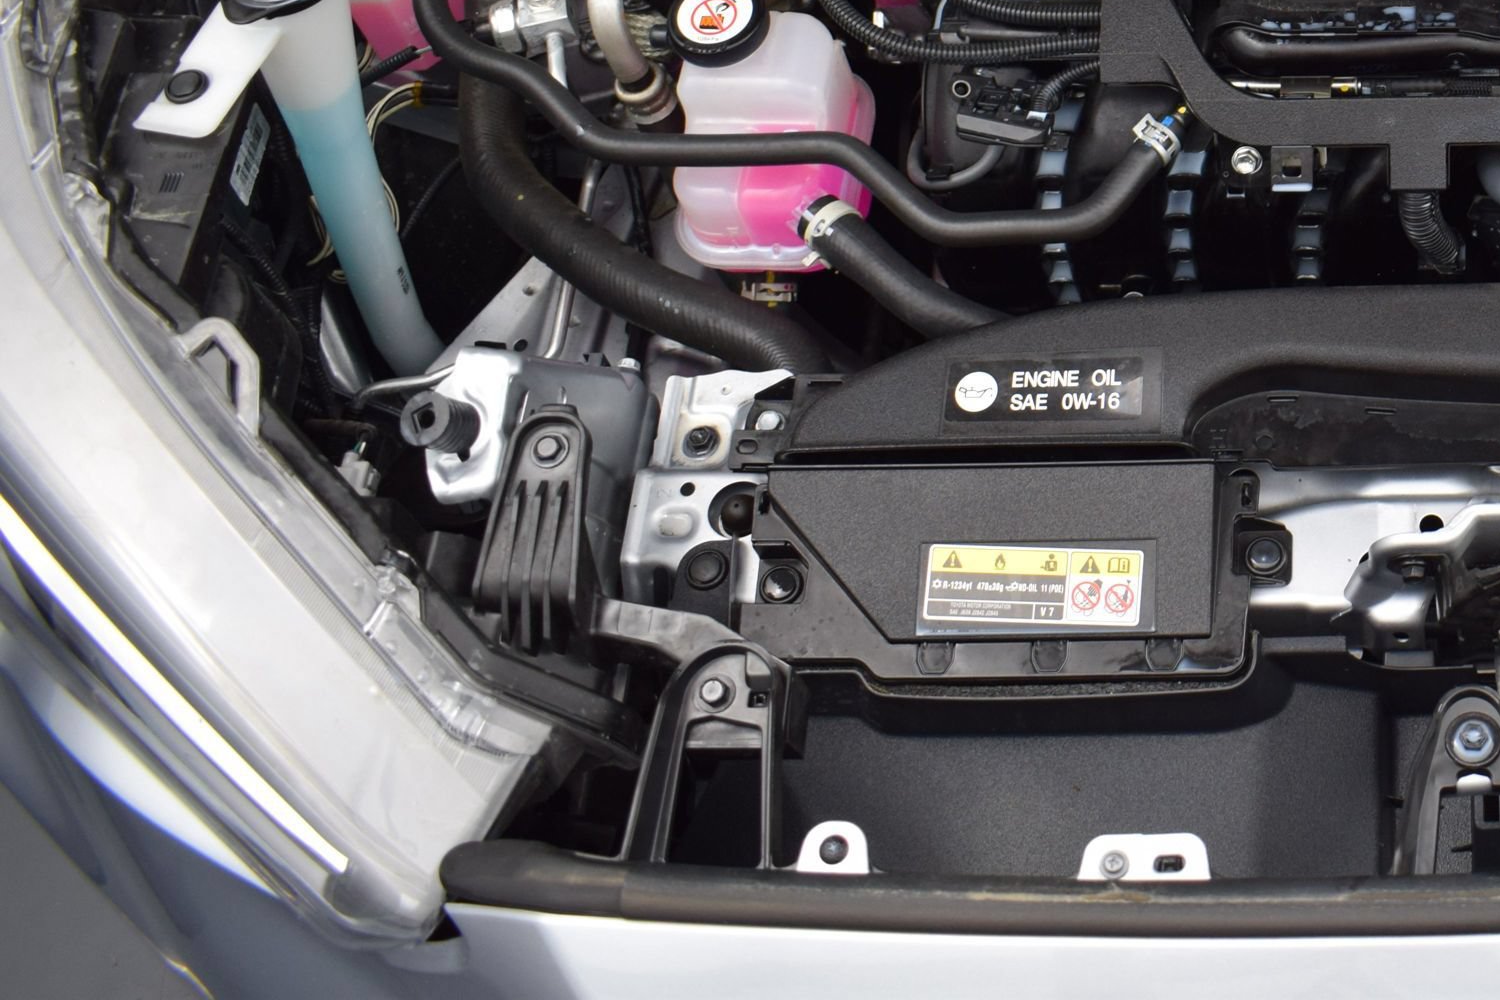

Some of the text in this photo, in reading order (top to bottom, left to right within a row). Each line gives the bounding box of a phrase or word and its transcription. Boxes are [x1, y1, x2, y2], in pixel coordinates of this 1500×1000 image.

[1011, 369, 1122, 388] ENGINE OIL
[1010, 392, 1121, 411] SAE 0W-16
[942, 579, 973, 592] R-1234yf
[1040, 606, 1055, 617] V 7
